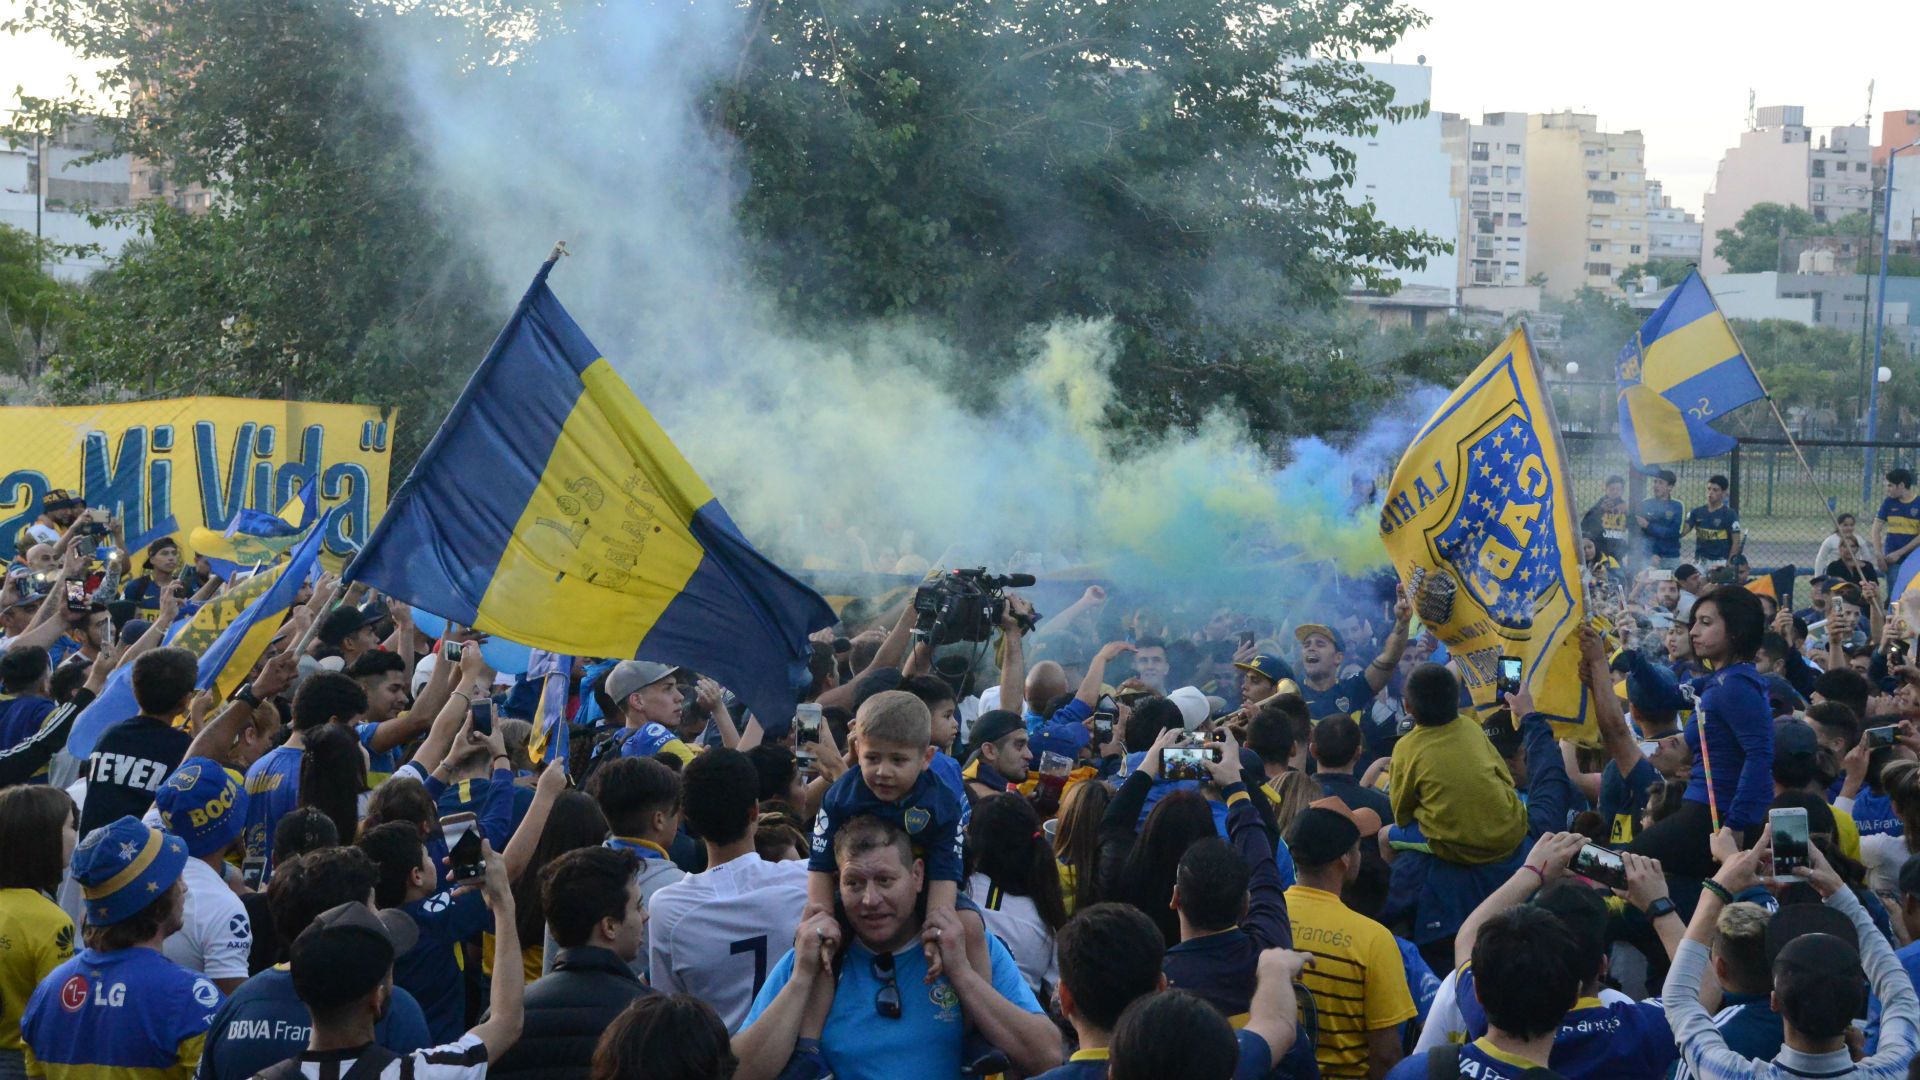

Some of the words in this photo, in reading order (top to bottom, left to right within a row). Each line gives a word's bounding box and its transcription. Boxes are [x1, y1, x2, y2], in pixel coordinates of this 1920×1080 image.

[82, 424, 175, 548] Mi
[89, 751, 168, 791] TEVEZ
[187, 779, 237, 828] BOCA
[730, 935, 767, 1006] 7
[94, 981, 126, 1007] LG
[227, 1020, 271, 1040] BBVA
